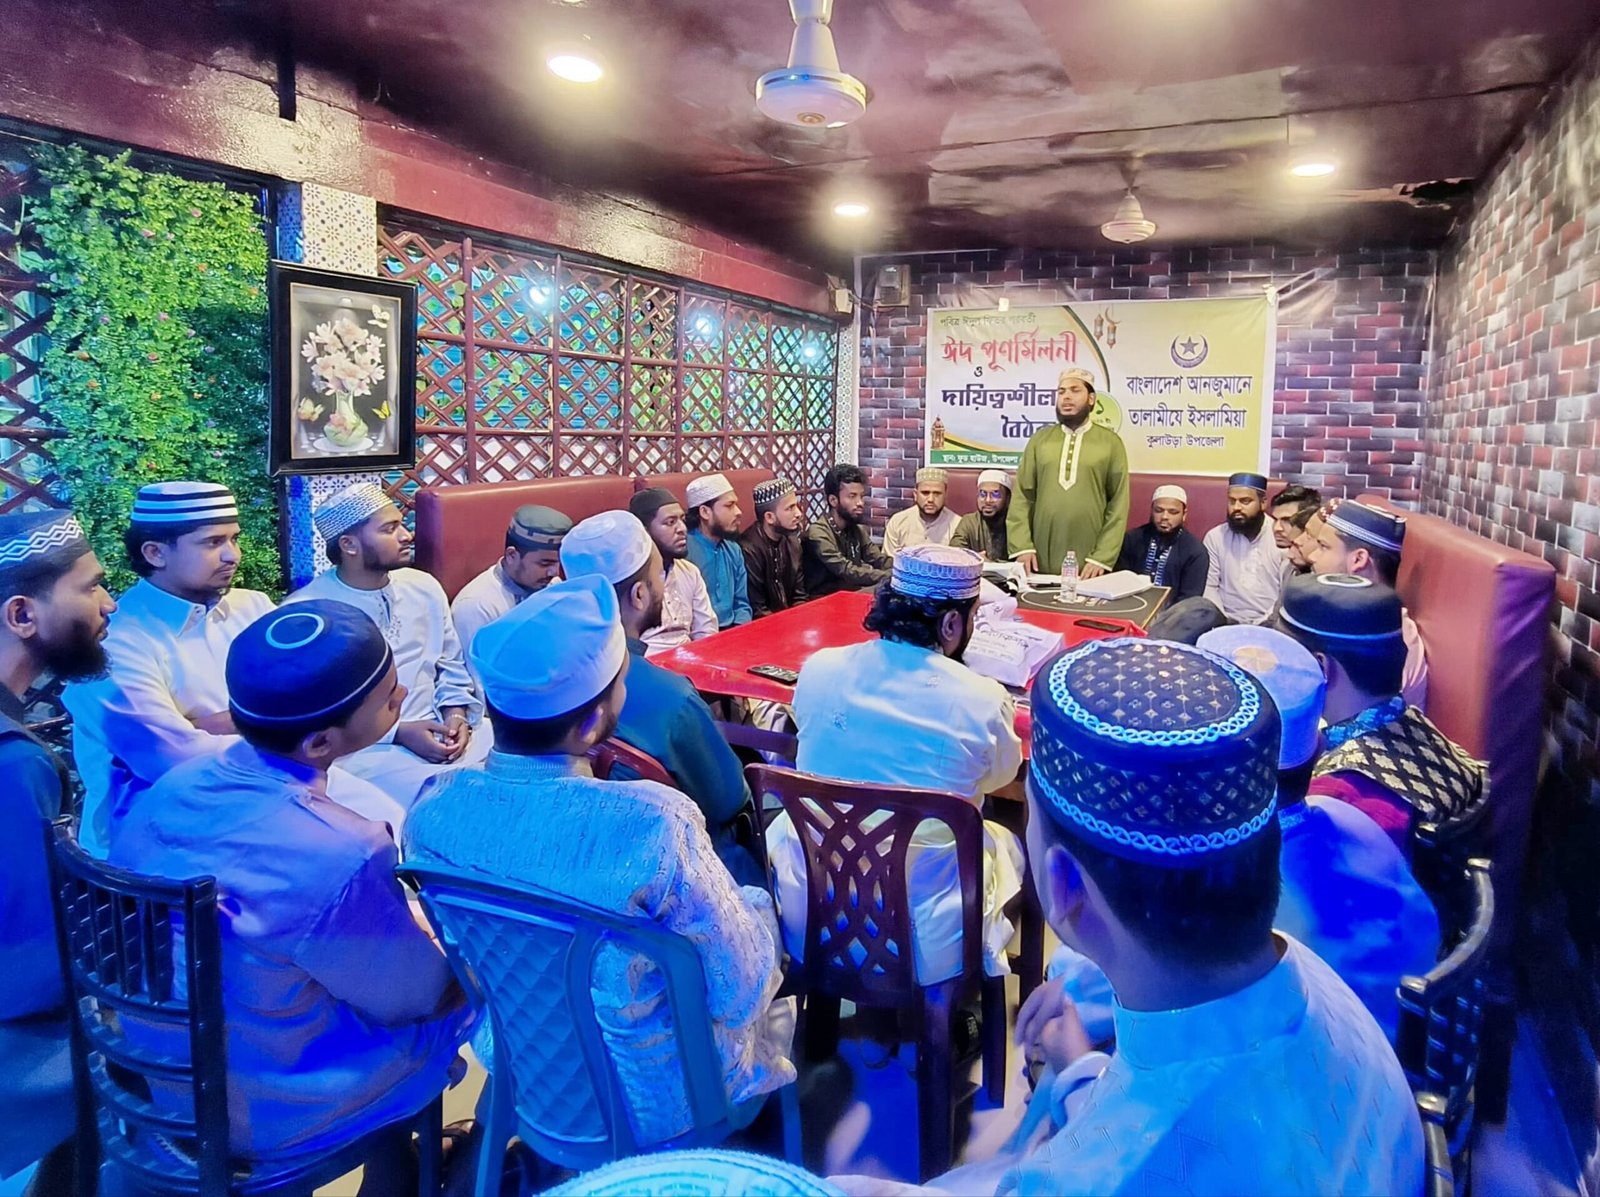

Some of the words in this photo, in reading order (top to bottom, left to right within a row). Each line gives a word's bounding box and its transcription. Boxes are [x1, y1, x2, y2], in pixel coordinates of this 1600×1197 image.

[941, 335, 974, 364] ঈদ
[974, 366, 983, 378] ও
[942, 383, 1058, 411] দায়িত্বশীল
[1126, 376, 1184, 396] বাংলাদেশ
[1187, 376, 1253, 398] আনজুমানে
[1128, 402, 1184, 428] তালামীযে
[1187, 403, 1247, 428] ইসলামিয়া
[1147, 433, 1182, 448] কুলাউড়া
[1186, 433, 1225, 448] উপজেলা
